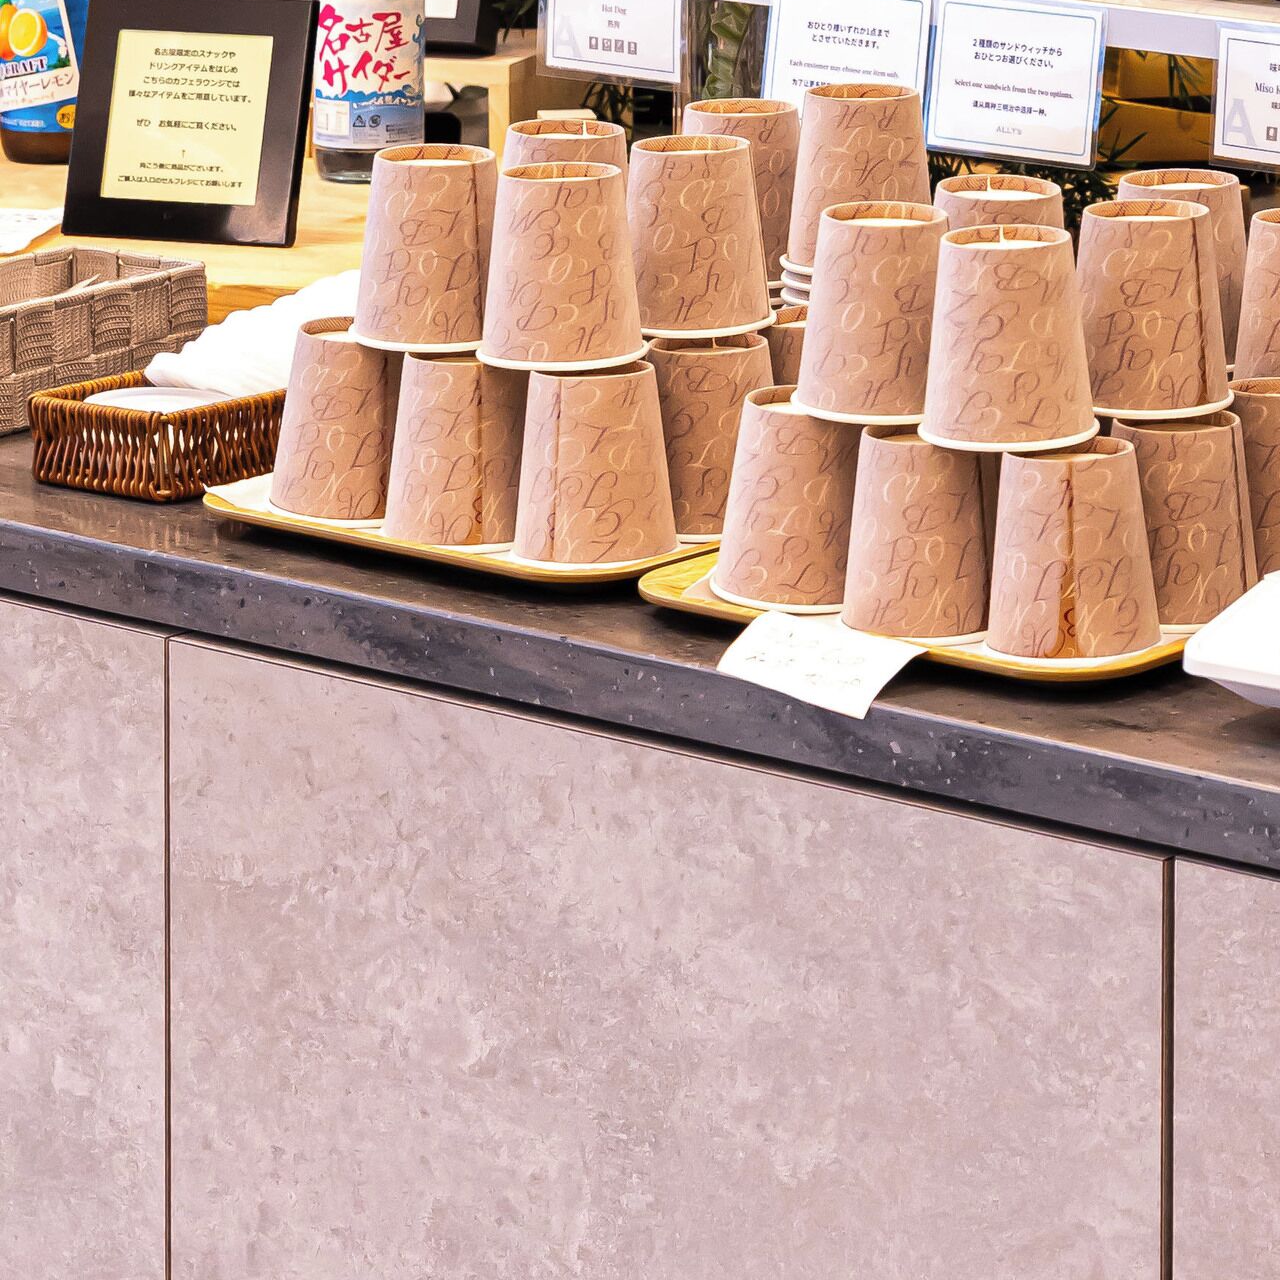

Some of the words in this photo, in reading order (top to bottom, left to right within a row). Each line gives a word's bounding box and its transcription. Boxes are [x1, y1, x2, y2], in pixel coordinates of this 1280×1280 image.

[318, 4, 410, 62] 名古屋
[807, 21, 890, 38] おひとり様いずれか1点まで
[812, 34, 880, 50] とさせていただきます。
[974, 51, 1054, 69] おひとつお選びください。
[322, 51, 411, 95] サイダー
[143, 75, 241, 89] こちらのカフェラウンジでは
[954, 79, 971, 88] Select
[984, 82, 1011, 93] sandwich
[1012, 85, 1026, 94] from
[1028, 87, 1037, 95] the
[1038, 89, 1049, 97] two
[1254, 82, 1274, 94] Miso
